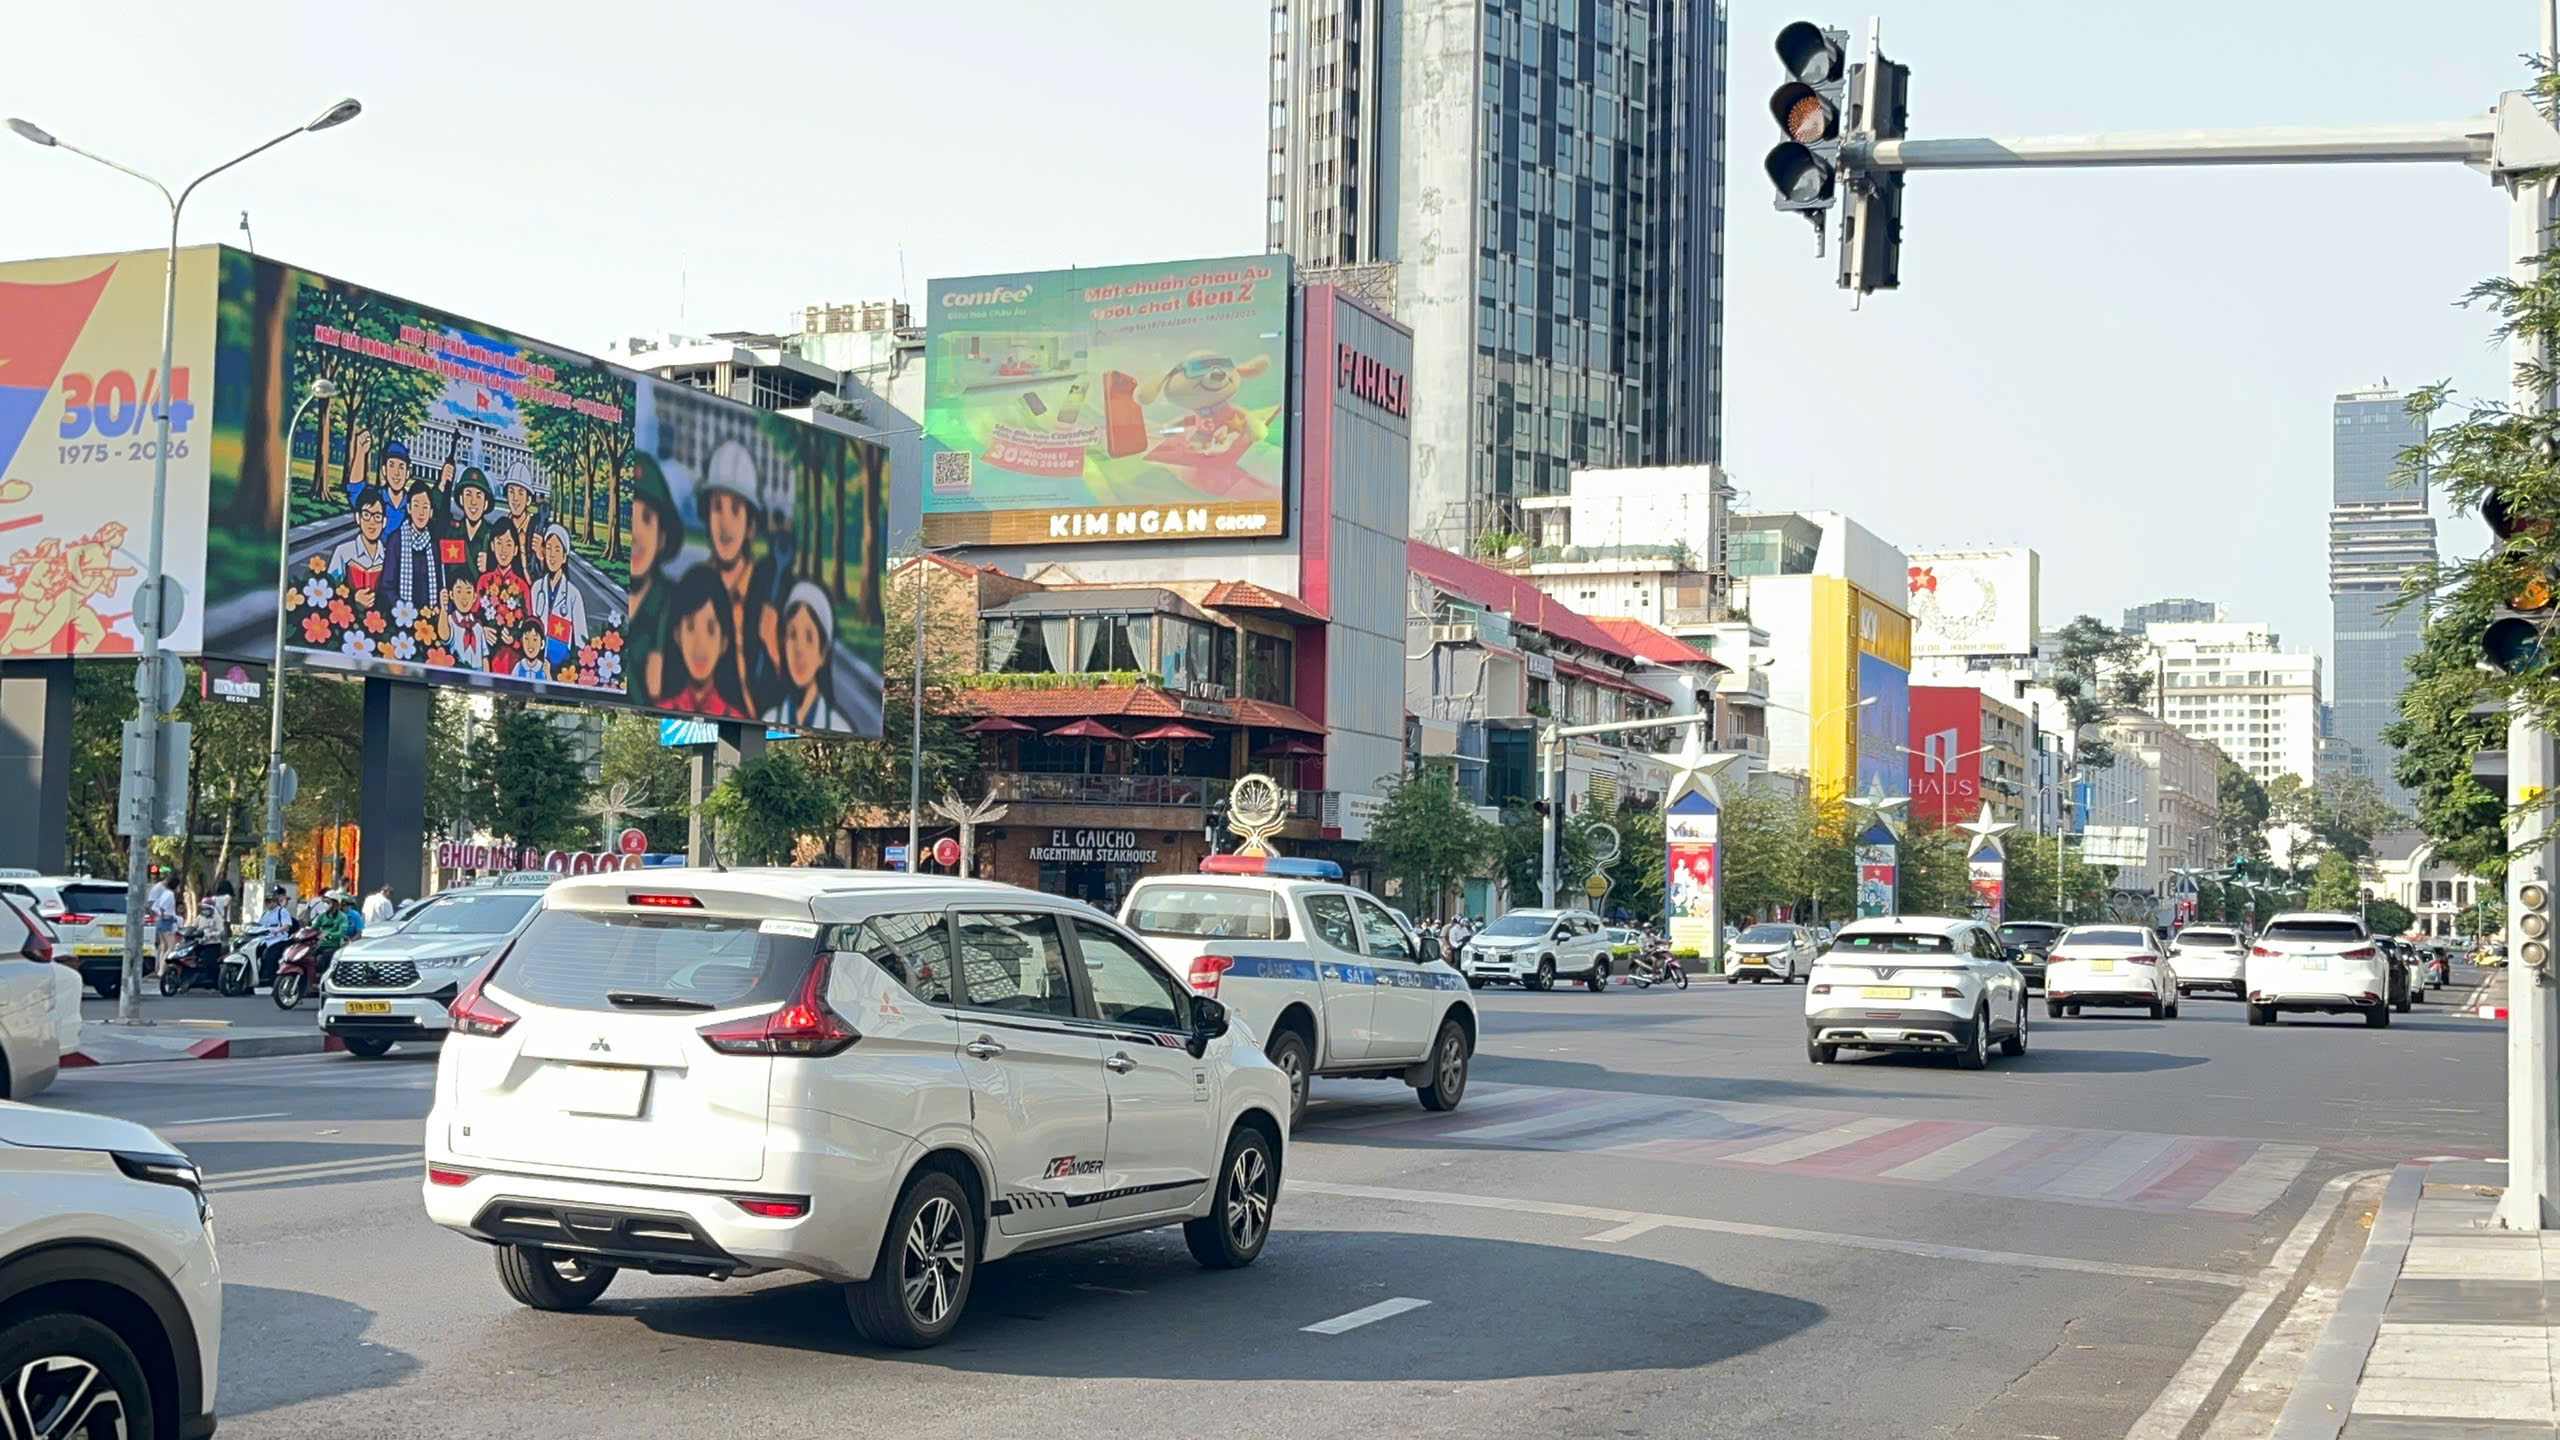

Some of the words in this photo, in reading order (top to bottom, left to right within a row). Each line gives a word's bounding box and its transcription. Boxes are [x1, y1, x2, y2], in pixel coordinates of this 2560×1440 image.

[59, 366, 195, 440] 30/4
[58, 444, 109, 464] 1975
[1050, 513, 1108, 537] KIM
[1215, 514, 1267, 531] GROUP
[1908, 778, 1973, 796] HAUS
[1052, 829, 1070, 847] EL
[1075, 830, 1135, 849] GAUCHO
[1029, 847, 1093, 861] ARGENTINIAN
[1096, 848, 1157, 863] STEAKHOUSE
[1044, 1157, 1103, 1178] XPANDER
